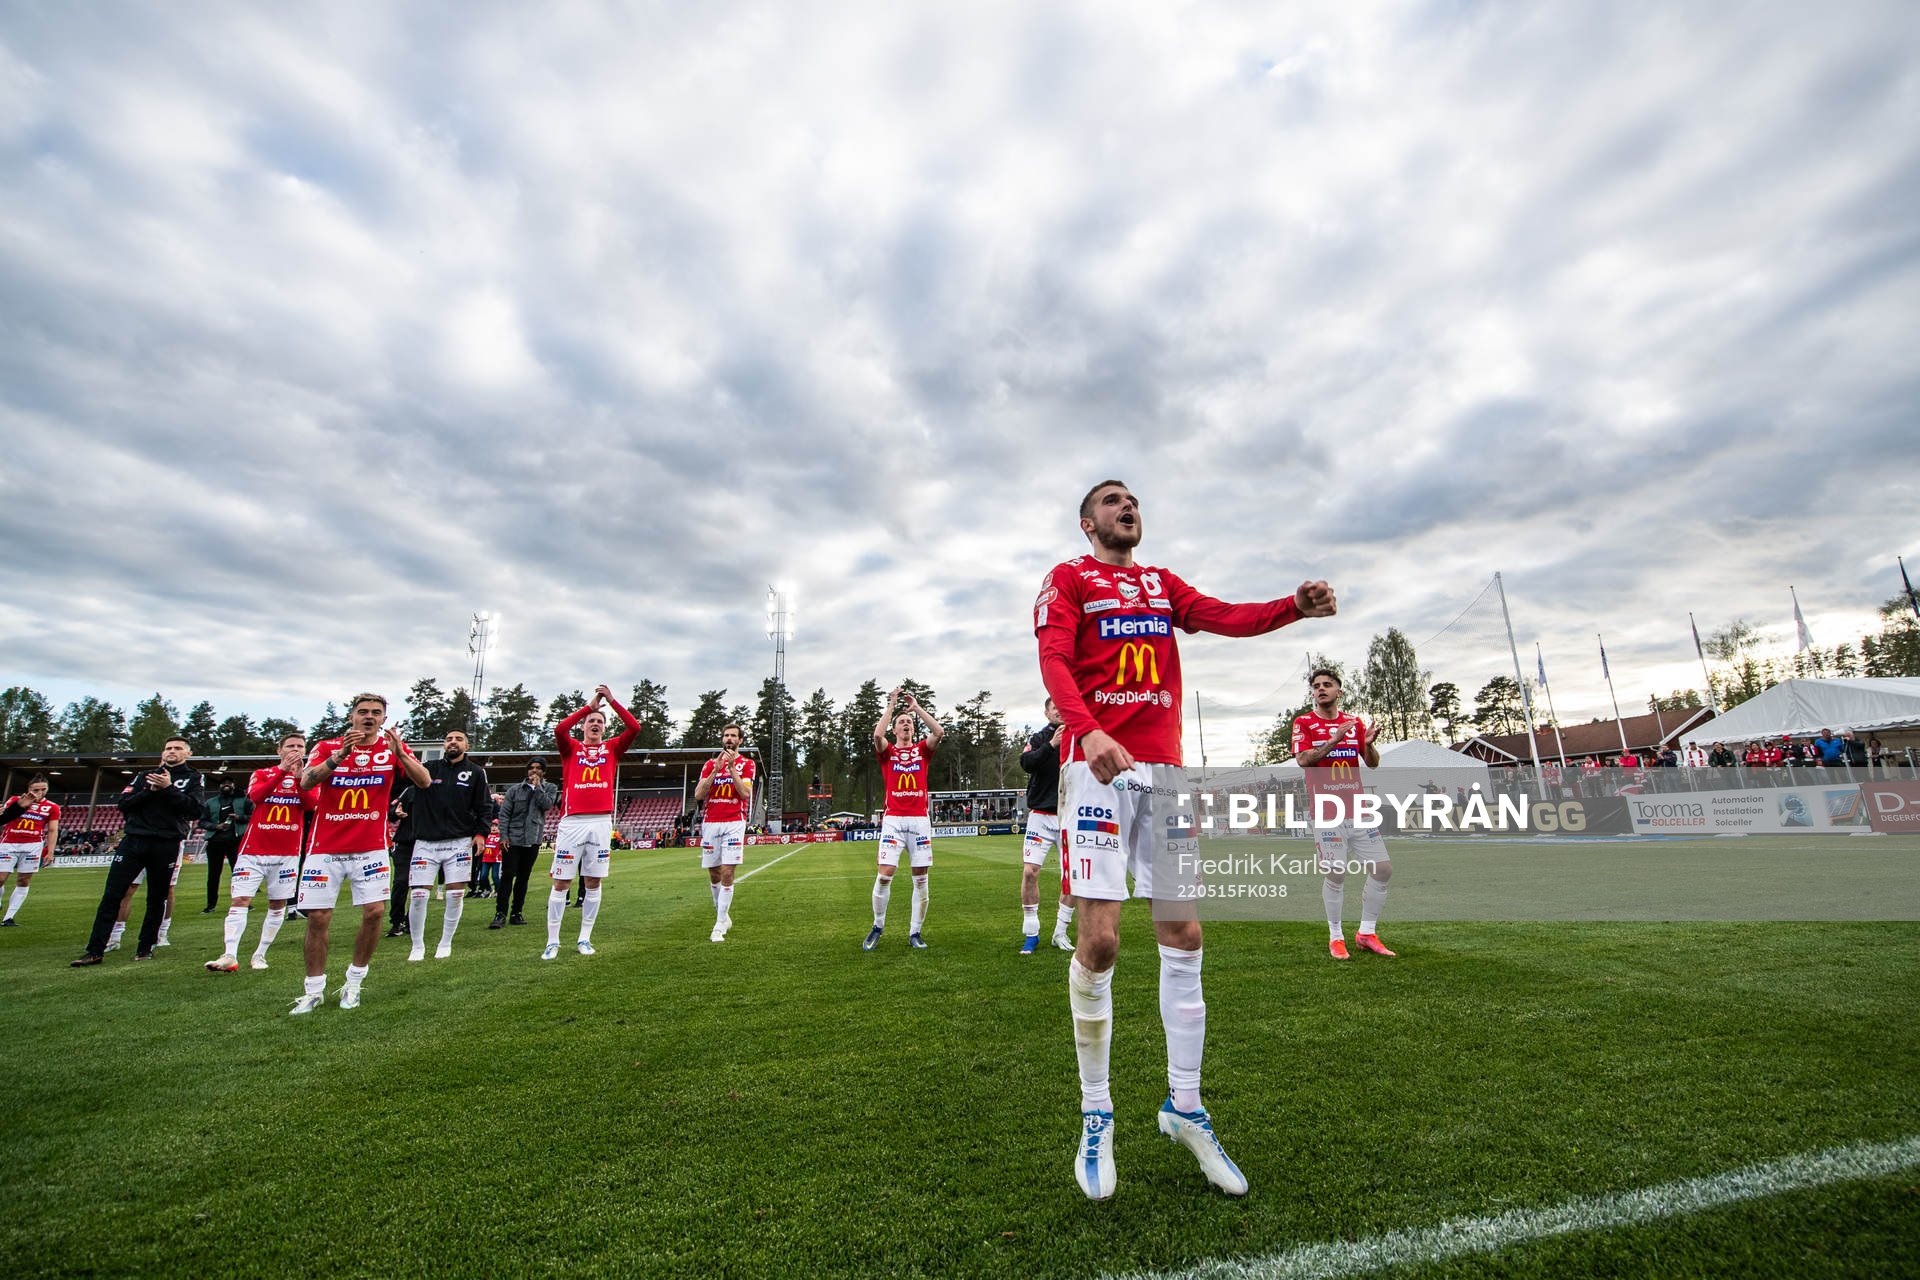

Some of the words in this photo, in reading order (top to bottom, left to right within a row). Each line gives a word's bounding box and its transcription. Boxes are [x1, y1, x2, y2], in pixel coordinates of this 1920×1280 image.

[1100, 616, 1168, 637] Hemia
[1095, 689, 1159, 705] ByggDialg
[1327, 748, 1357, 758] elmia
[331, 775, 384, 787] Helmia
[1711, 795, 1765, 805] Automation
[1077, 805, 1113, 820] CEOS
[1632, 801, 1705, 818] Toroma
[1713, 807, 1764, 816] Installation
[325, 812, 370, 821] ByggDialog
[1651, 817, 1706, 827] SOLCELLER
[1715, 819, 1753, 827] Solceller
[1076, 834, 1119, 848] D-LAB
[363, 861, 383, 871] CEOS
